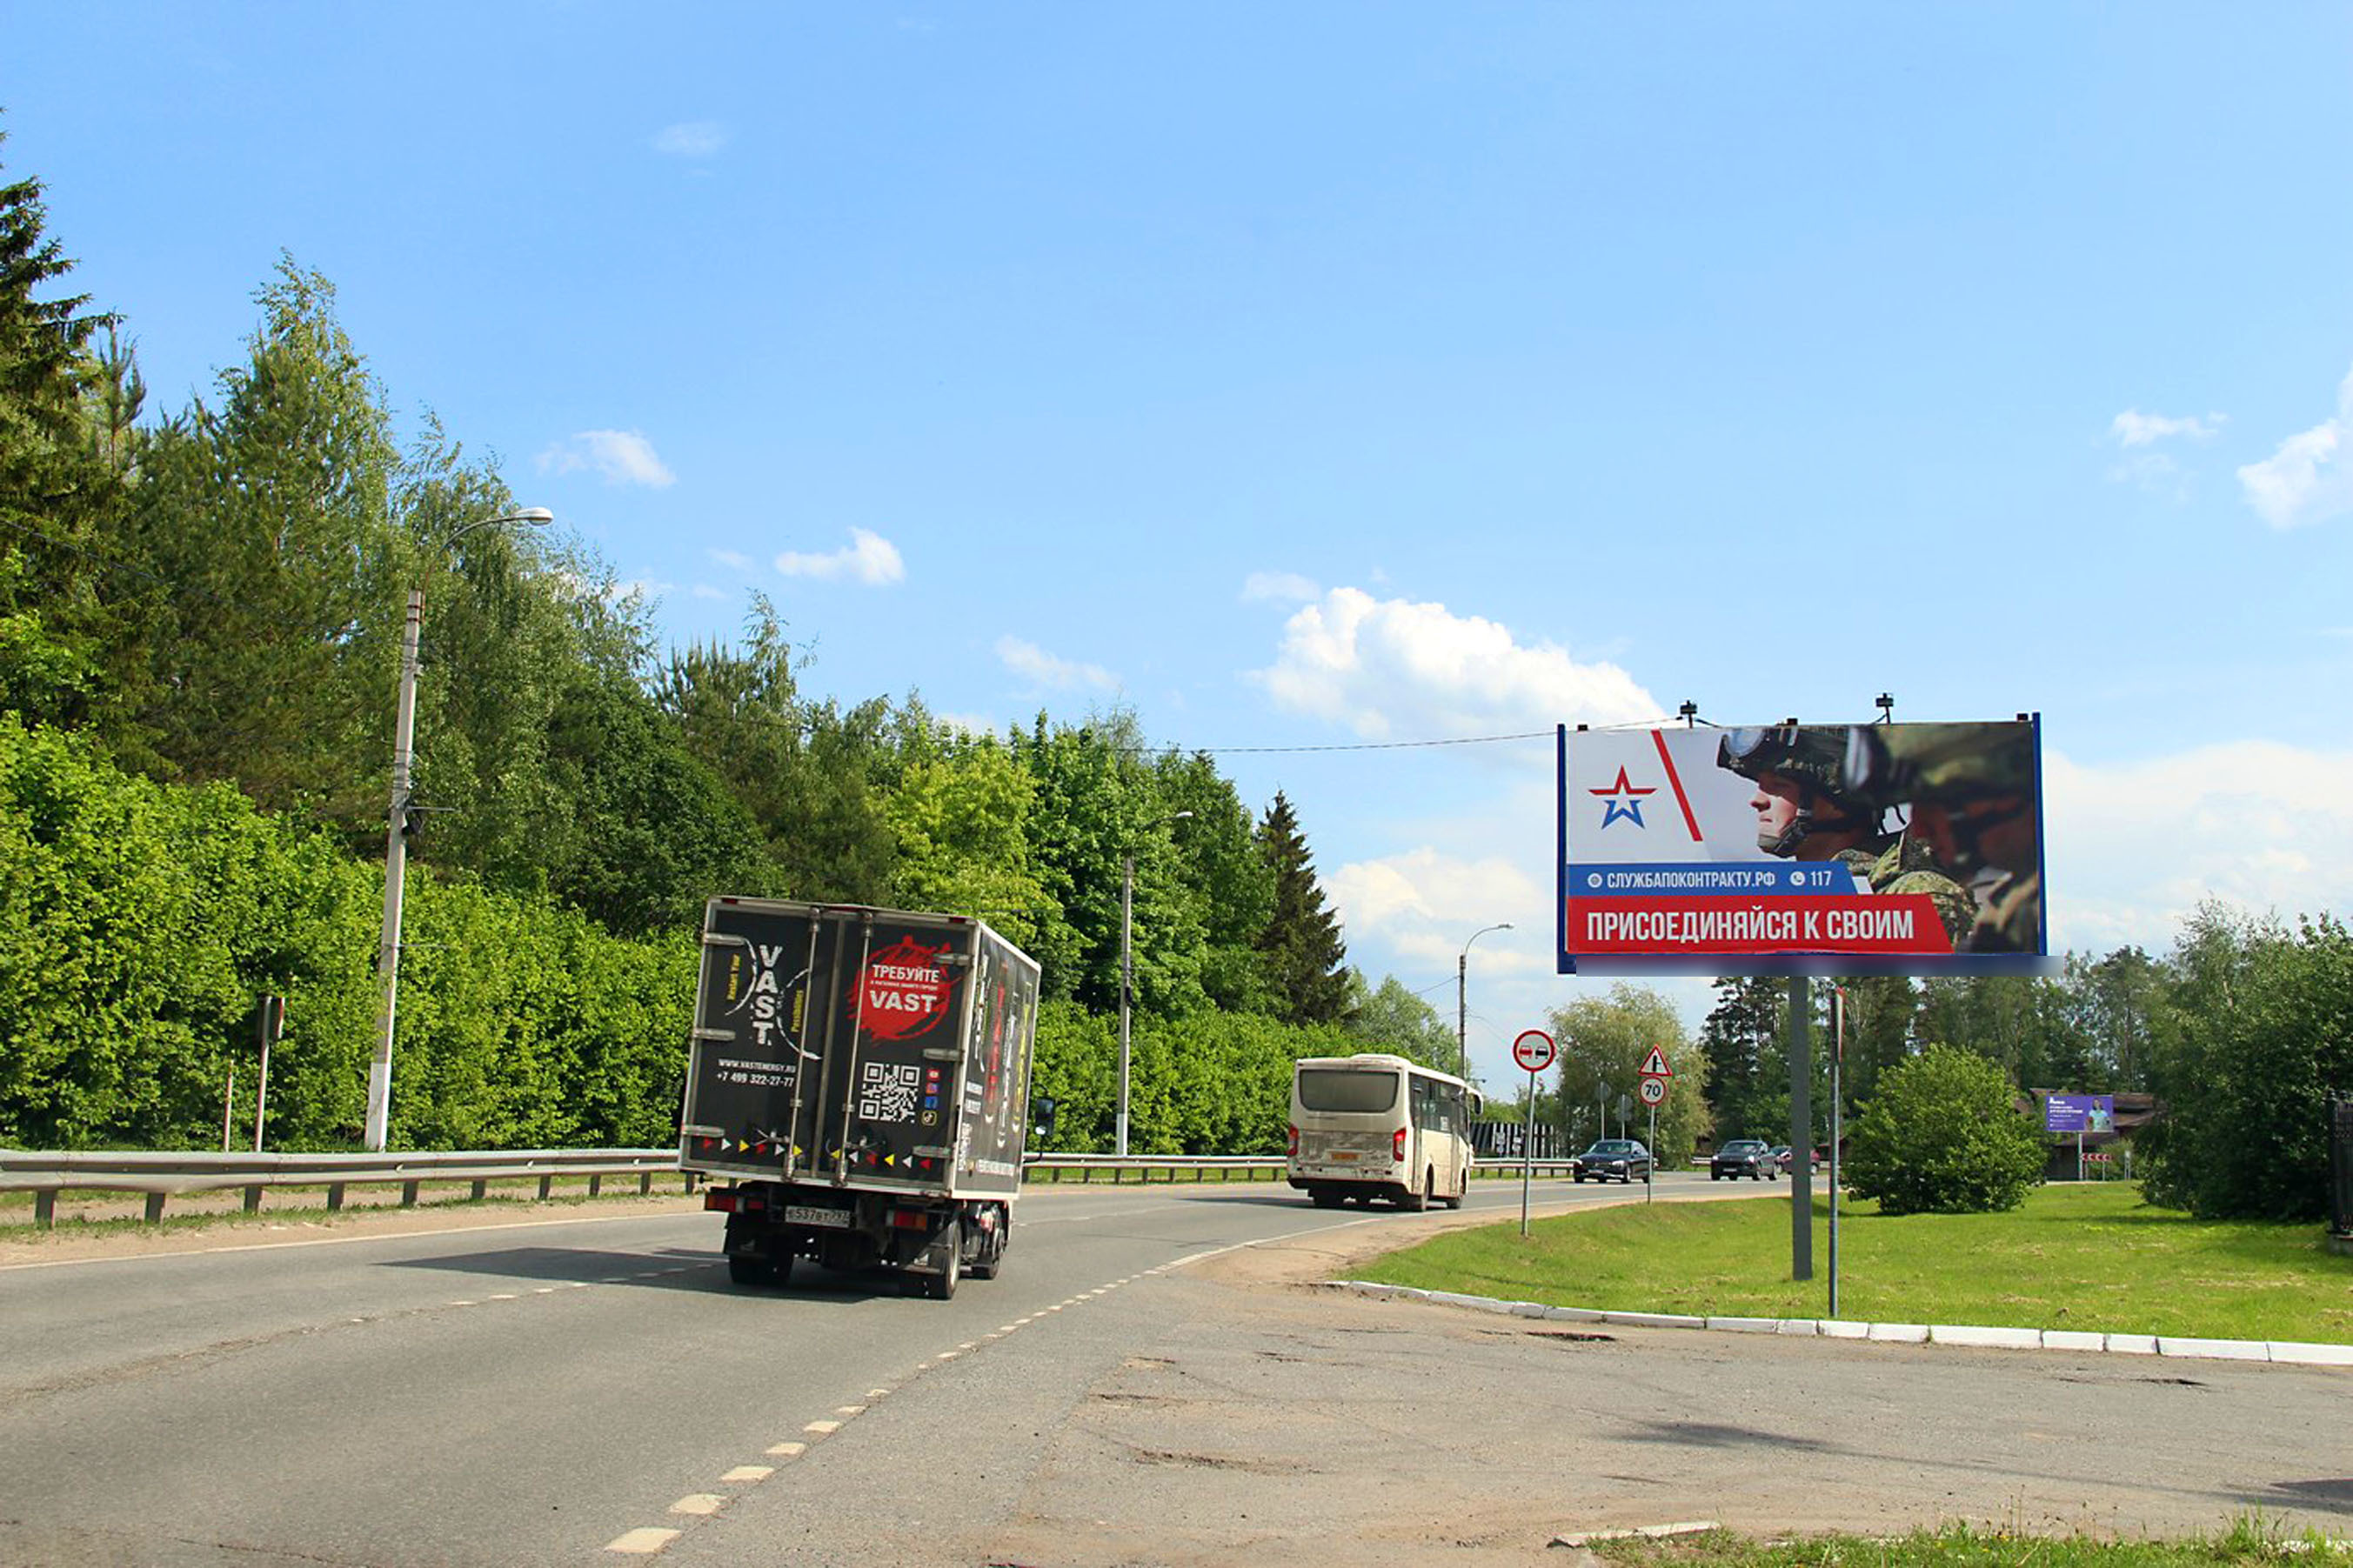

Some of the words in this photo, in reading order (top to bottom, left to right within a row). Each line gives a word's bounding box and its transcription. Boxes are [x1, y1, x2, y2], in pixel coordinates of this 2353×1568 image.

[1608, 871, 1775, 888] СЛУЖБАПОКОНТРАКТУ.РФ
[1811, 871, 1832, 886] 117
[1588, 905, 1797, 944] ПРИСОЕДИНЯЙСЯ
[1805, 911, 1820, 939] К
[1828, 911, 1913, 939] СВОИМ
[872, 964, 940, 983] ТРЕБУЙТЕ
[752, 944, 783, 1044] VAST
[870, 990, 937, 1012] VAST
[717, 1071, 728, 1081] +7
[749, 1073, 794, 1087] 322-27-77
[1646, 1084, 1661, 1097] 70
